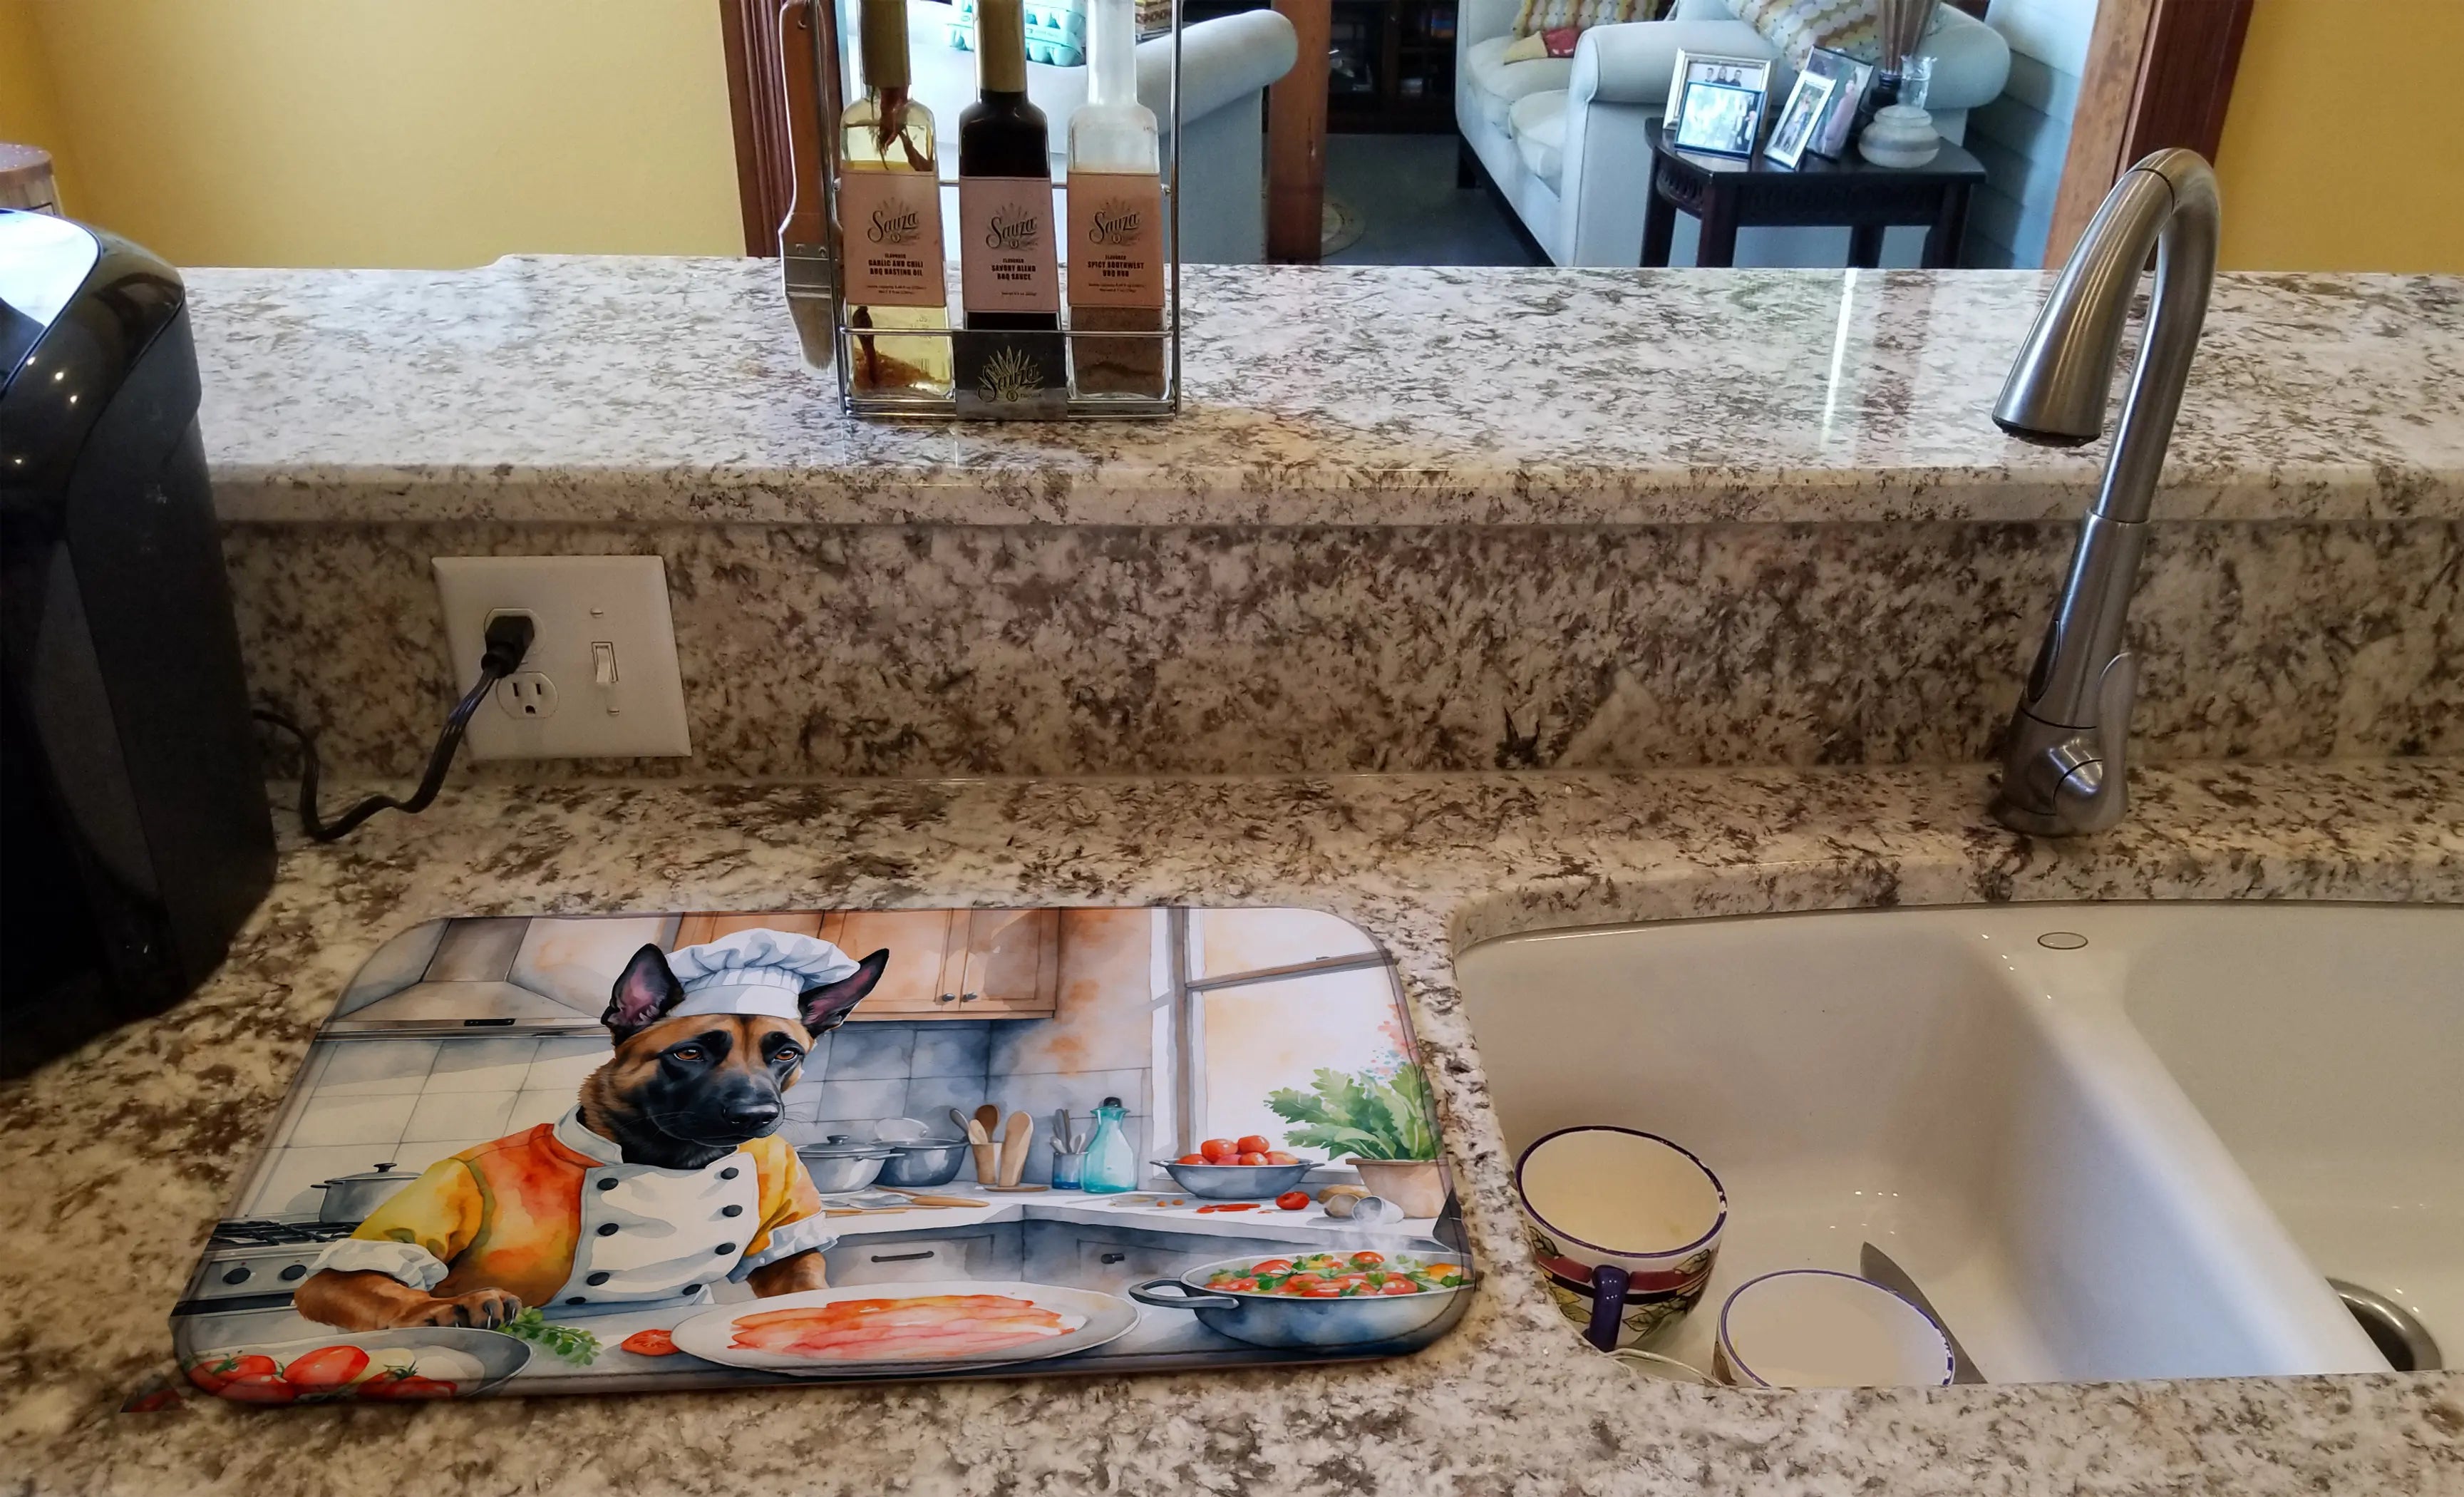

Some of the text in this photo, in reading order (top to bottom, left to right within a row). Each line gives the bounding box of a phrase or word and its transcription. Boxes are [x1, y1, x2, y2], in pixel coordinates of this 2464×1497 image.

[867, 210, 919, 243] Sauza
[986, 216, 1037, 249] Sauza
[1089, 211, 1140, 244] Sauza
[977, 363, 1041, 403] Sauza
